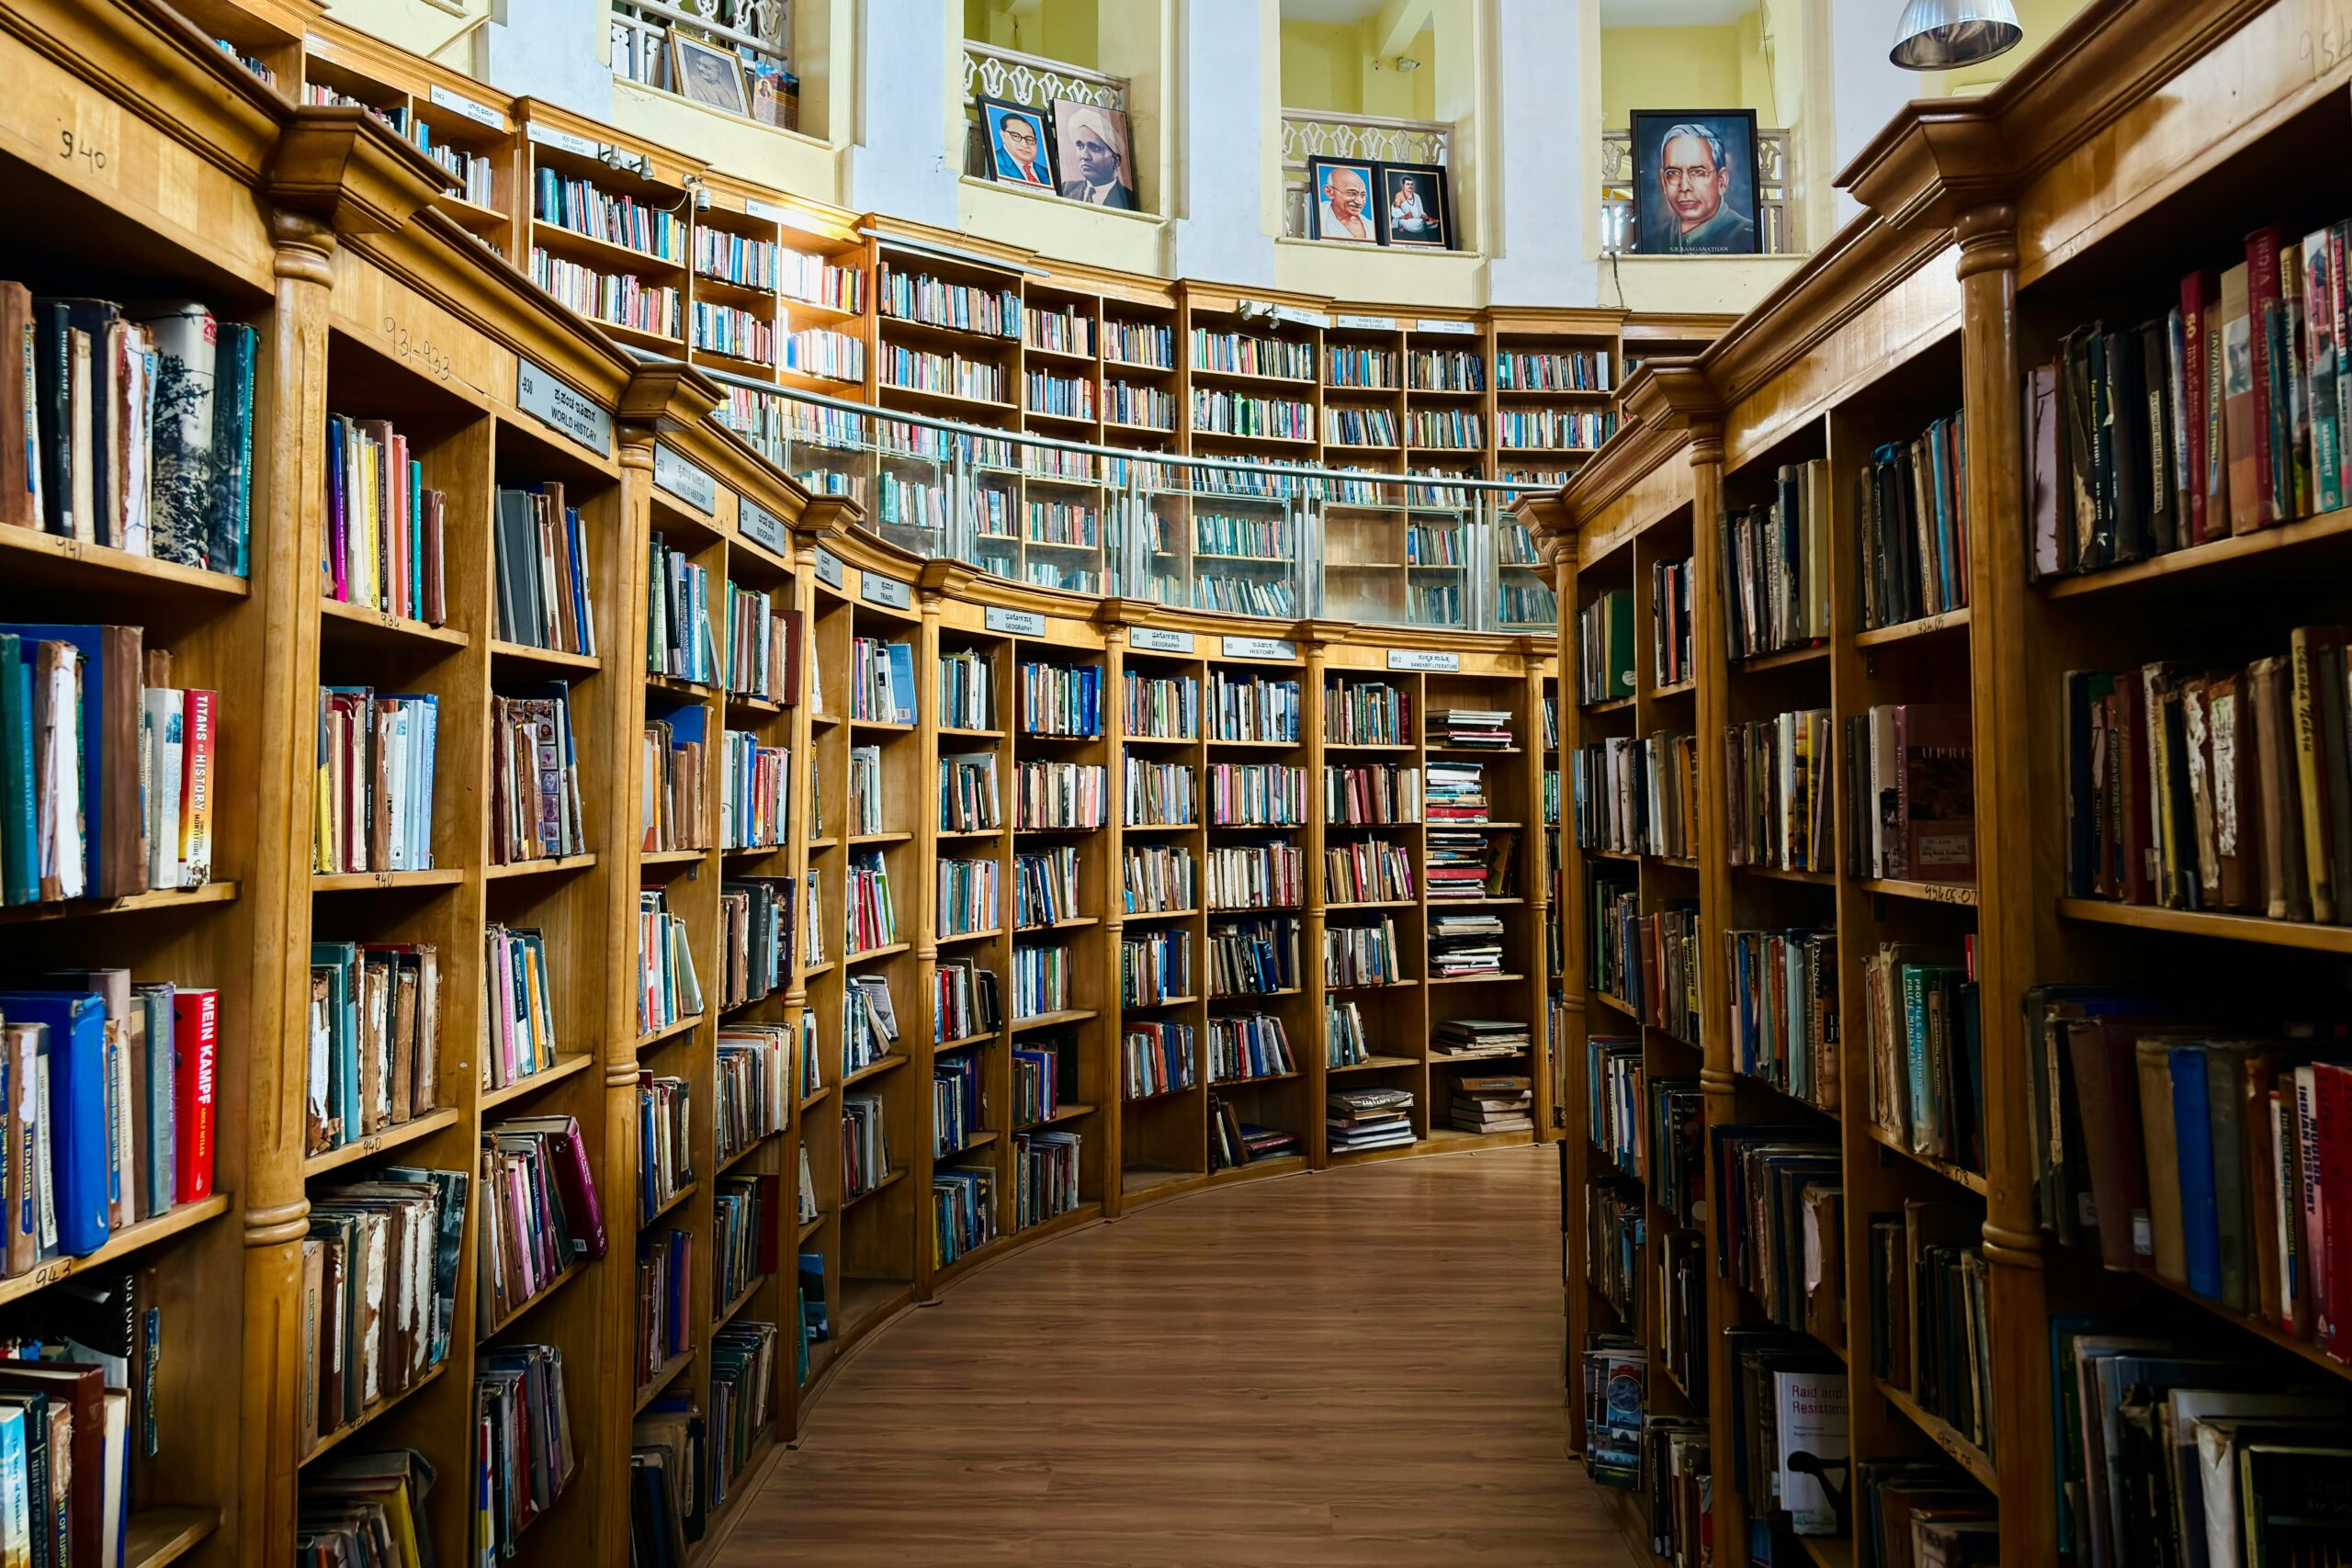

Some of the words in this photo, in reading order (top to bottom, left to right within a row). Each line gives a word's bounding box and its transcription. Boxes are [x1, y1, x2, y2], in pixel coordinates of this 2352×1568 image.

[60, 130, 107, 174] 940
[2257, 236, 2271, 286] INDIA
[61, 331, 69, 367] WORLD
[383, 316, 450, 381] 931-933
[62, 368, 70, 390] WAR
[2211, 332, 2220, 416] JAWAHARLAL
[551, 405, 573, 429] WORLD
[573, 419, 597, 444] HISTORY
[676, 479, 690, 496] WORLD
[690, 490, 707, 505] HISTORY
[757, 526, 776, 545] BIOGRAPHY
[880, 592, 895, 603] TRAVEL
[381, 614, 400, 630] 934
[1005, 622, 1033, 632] GEOGRAPHY
[1151, 640, 1180, 649] GEOGRAPHY
[196, 695, 209, 741] TITANS
[1922, 746, 1973, 759] UPRIS
[25, 774, 33, 820] BRITAIN
[193, 753, 207, 812] HISTORY
[375, 874, 393, 889] 940
[201, 995, 215, 1041] MEIN
[1914, 978, 1922, 1028] PROFILES
[198, 1043, 214, 1105] KAMPF
[2299, 1086, 2311, 1140] INDIAN
[25, 1132, 32, 1145] IN
[364, 1138, 381, 1156] 940
[23, 1148, 31, 1200] DANGER
[2303, 1145, 2315, 1214] HISTORY
[36, 1258, 72, 1285] 943
[1792, 1384, 1816, 1398] Raid
[1821, 1386, 1843, 1399] and
[1792, 1401, 1849, 1415] Resistanc
[58, 1517, 67, 1531] OF
[58, 1533, 67, 1568] EUROP
